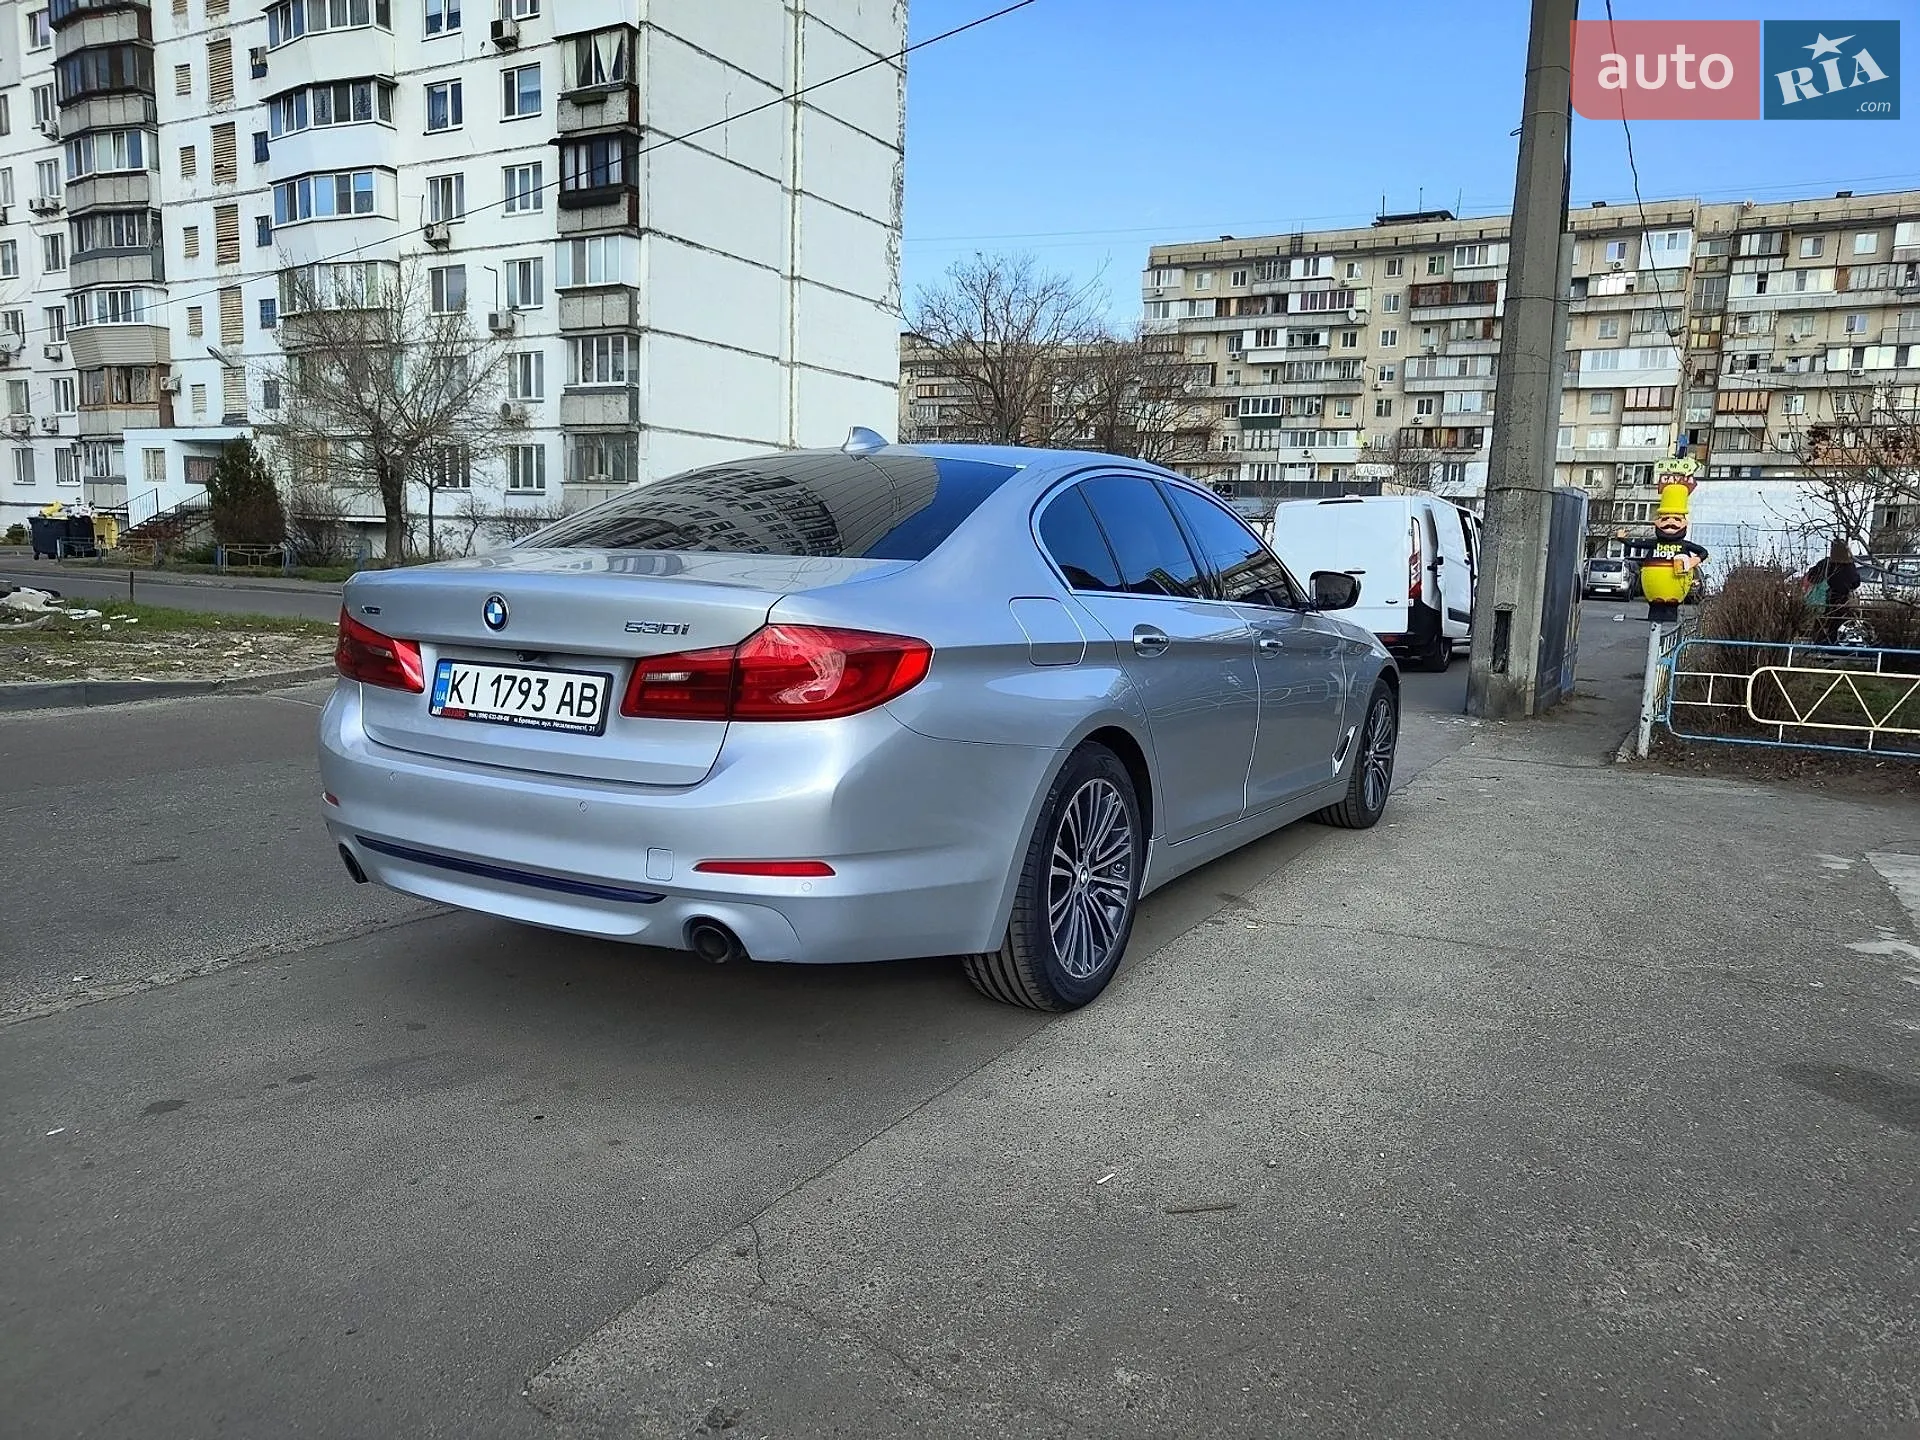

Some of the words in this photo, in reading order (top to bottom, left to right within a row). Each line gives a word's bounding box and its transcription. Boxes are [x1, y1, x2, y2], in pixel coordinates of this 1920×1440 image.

[1657, 543, 1682, 552] beer
[624, 620, 690, 635] 530i
[436, 691, 446, 700] UA
[449, 670, 480, 705] KI
[490, 674, 549, 711] 1793
[556, 682, 598, 718] AB
